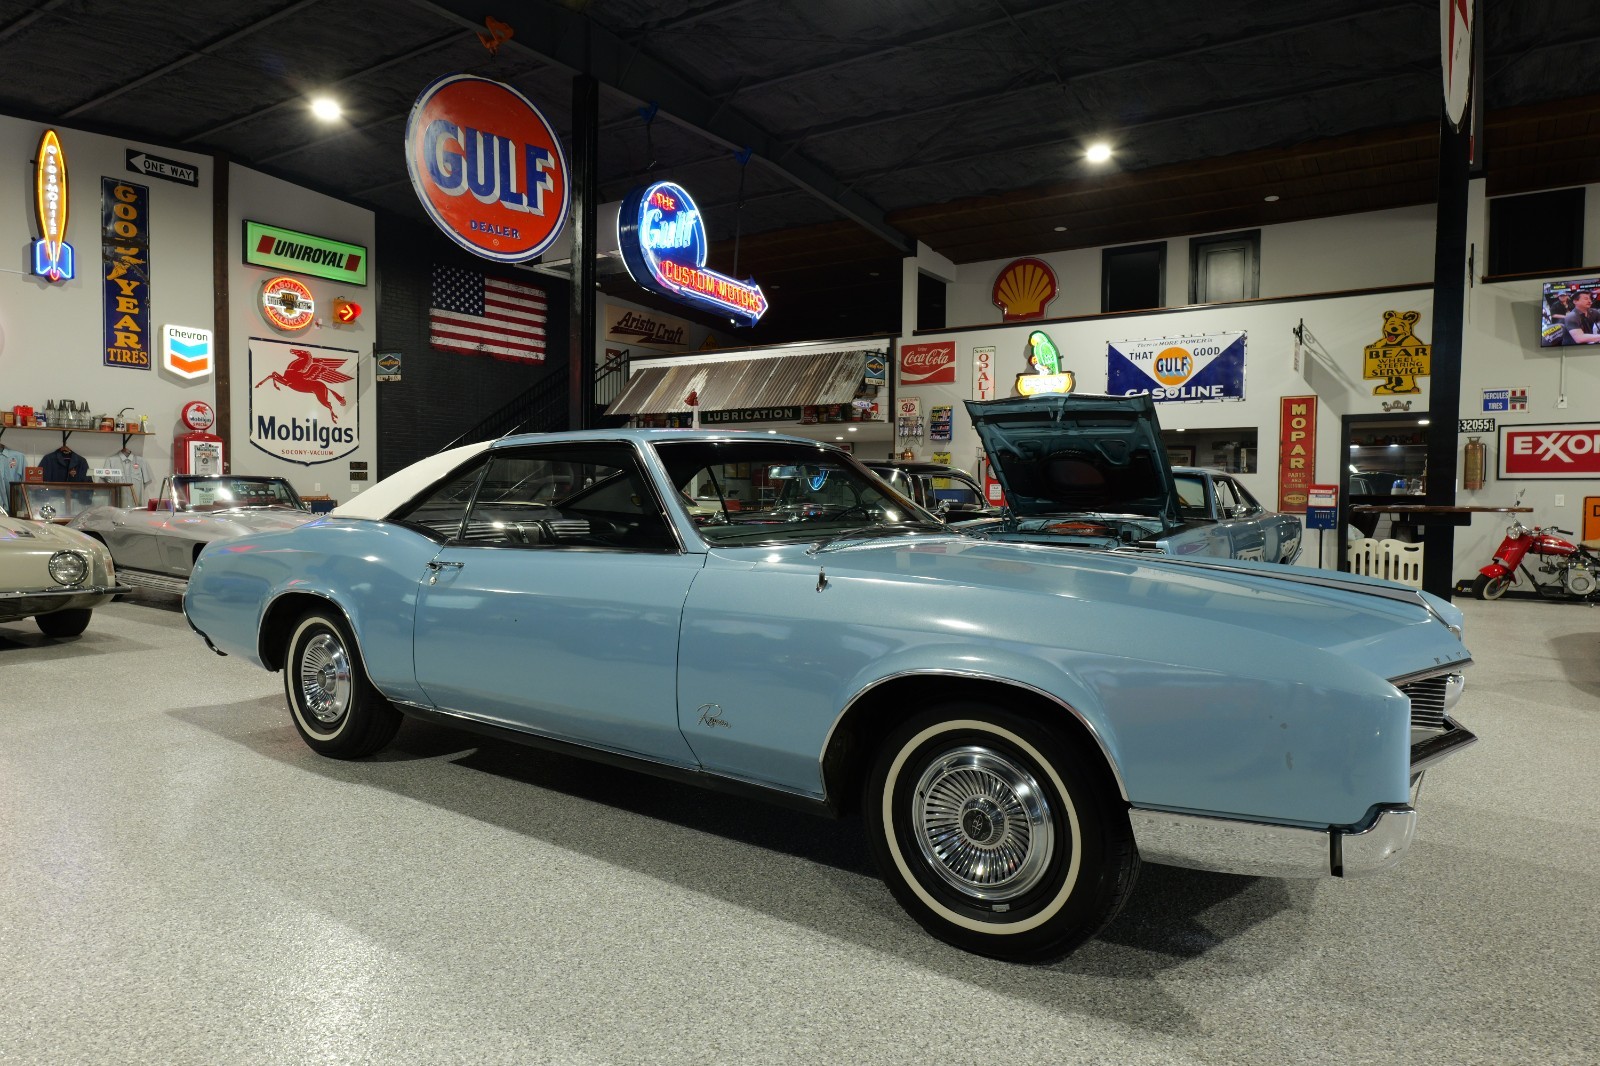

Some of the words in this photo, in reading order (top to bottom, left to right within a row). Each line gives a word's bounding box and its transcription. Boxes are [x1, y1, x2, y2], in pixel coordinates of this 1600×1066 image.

[143, 160, 165, 173] ONE
[170, 166, 192, 180] WAY
[423, 119, 555, 217] GULF
[653, 193, 675, 210] THE
[470, 219, 521, 240] DEALER
[641, 208, 699, 249] Gulf
[273, 239, 345, 269] UNIROYAL
[270, 281, 310, 299] GASOLINE
[662, 260, 715, 292] CUSTOM
[717, 280, 763, 312] MOTORS
[169, 328, 208, 341] Chevron
[617, 311, 656, 332] Aristo
[655, 323, 684, 343] Craft
[107, 347, 148, 364] TIRES
[1129, 351, 1154, 361] THAT
[1193, 346, 1220, 357] GOOD
[1369, 347, 1427, 359] BEAR
[1156, 356, 1191, 378] GULF
[1371, 367, 1424, 377] SERVICE
[1124, 384, 1224, 399] GASOLINE
[1483, 391, 1509, 399] HERCULES
[707, 408, 794, 421] LUBRICATION
[902, 402, 915, 413] STP
[1488, 402, 1503, 410] TIRES
[257, 415, 354, 449] Mobilgas
[1461, 419, 1489, 430] 32055
[1290, 403, 1307, 469] MOPAR
[1513, 432, 1600, 463] EXXO
